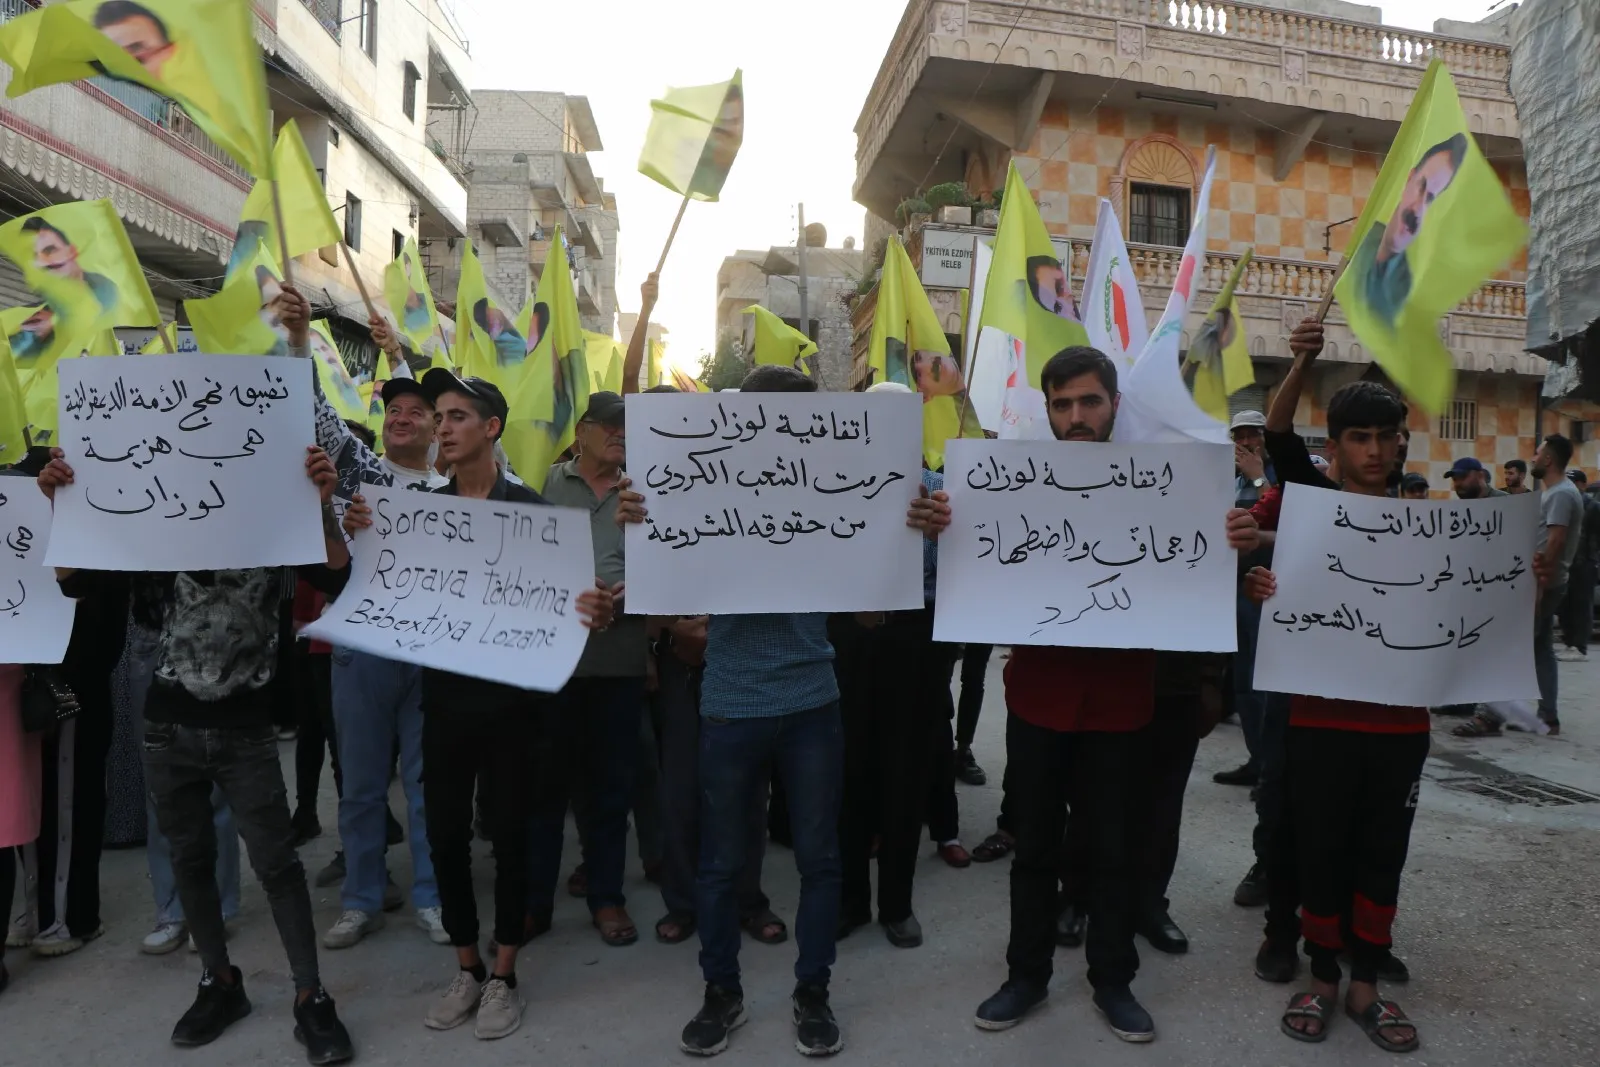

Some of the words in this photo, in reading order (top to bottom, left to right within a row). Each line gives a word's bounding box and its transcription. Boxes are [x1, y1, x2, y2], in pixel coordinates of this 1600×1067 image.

[941, 260, 962, 269] HELEB
[131, 379, 188, 413] الأمة
[178, 376, 223, 432] نهج
[229, 368, 289, 415] تطبيق
[649, 403, 766, 442] لوزان
[775, 410, 872, 445] إتفاقية
[82, 435, 172, 469] هزيمة
[178, 428, 264, 467] هي
[646, 446, 733, 495] الكردي
[736, 456, 807, 496] الشعب
[813, 471, 905, 500] حرمت
[967, 456, 1036, 491] لوزان
[1043, 456, 1173, 499] إتفاقية
[86, 476, 226, 520] لوزان
[644, 508, 745, 549] المشروعة
[747, 511, 826, 544] حقوقه
[831, 516, 866, 538] من
[1334, 505, 1442, 542] الذاتية
[1449, 508, 1503, 542] الإدارة
[370, 549, 468, 599] Rojava
[1327, 554, 1454, 595] لحرية
[1462, 555, 1526, 592] تجسيد
[1273, 603, 1364, 633] الشعوب
[1365, 616, 1494, 650] كافة
